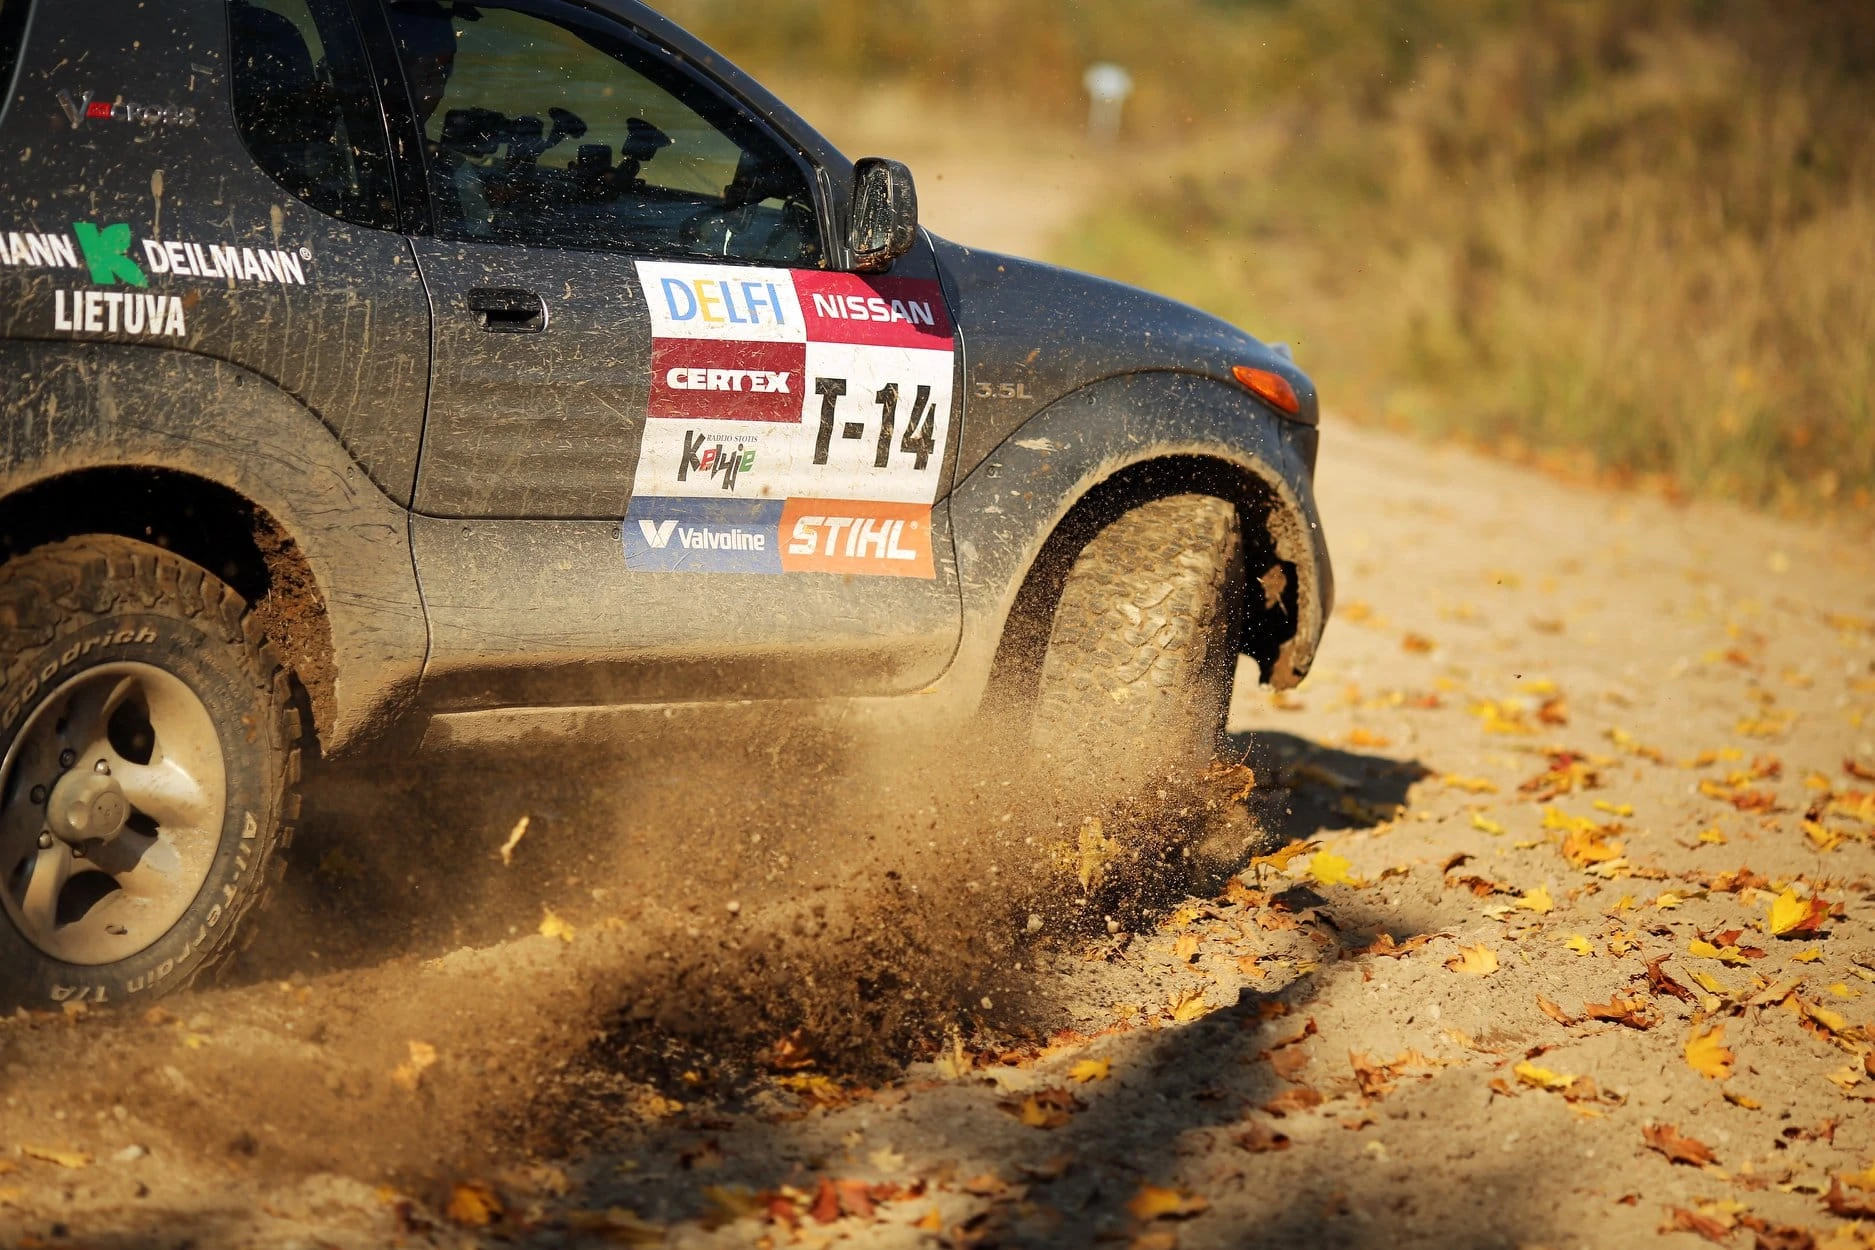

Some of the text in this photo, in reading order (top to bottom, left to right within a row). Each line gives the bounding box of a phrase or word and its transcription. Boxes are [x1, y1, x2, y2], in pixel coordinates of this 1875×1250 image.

[142, 239, 306, 285] DEILMANN
[54, 289, 186, 337] LIETUVA
[661, 278, 785, 325] DELFI
[812, 293, 935, 325] NISSAN
[666, 367, 790, 394] CERTEX
[974, 382, 1033, 399] 3.5L
[812, 377, 937, 471] T-14
[678, 527, 765, 551] Valvoline
[788, 515, 917, 561] STIHL
